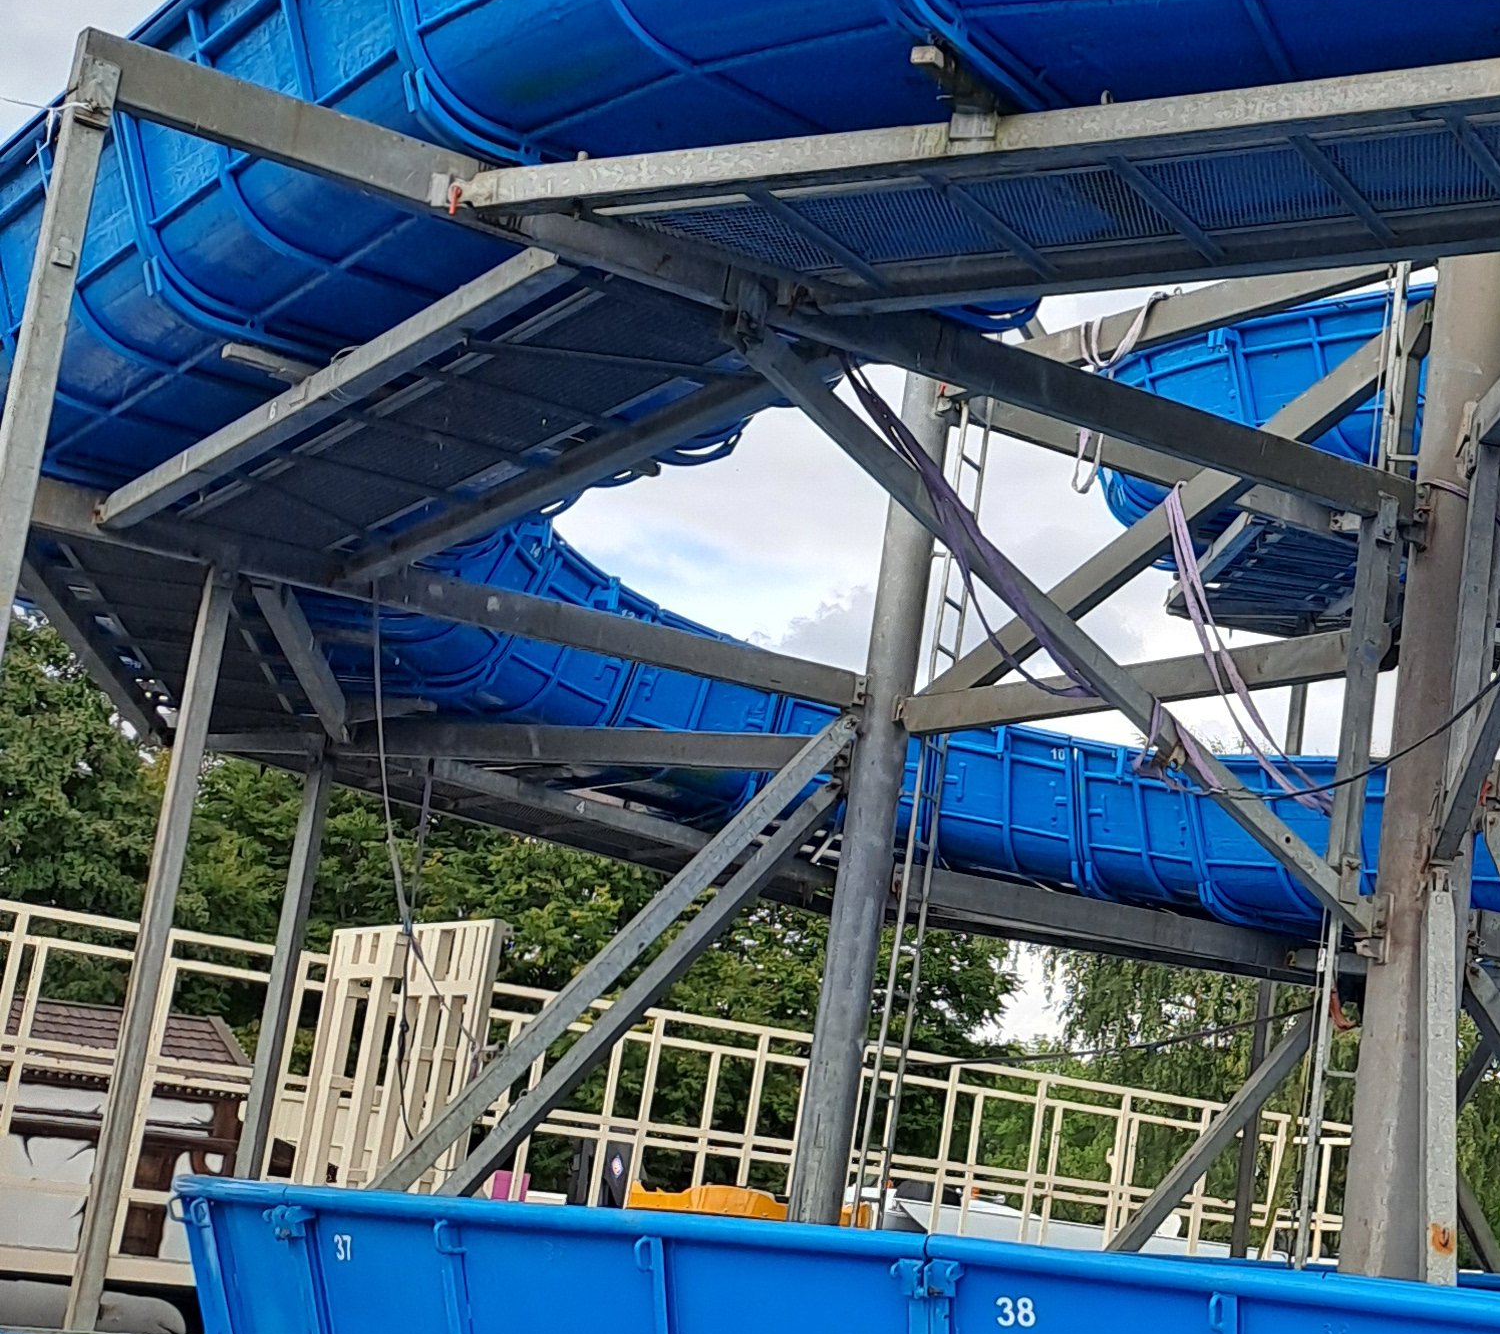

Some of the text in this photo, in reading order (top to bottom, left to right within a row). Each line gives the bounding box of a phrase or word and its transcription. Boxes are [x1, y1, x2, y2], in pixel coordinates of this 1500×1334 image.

[269, 401, 277, 421] 6
[1050, 747, 1066, 761] 10
[575, 800, 586, 814] 4
[333, 1234, 352, 1261] 37
[995, 1296, 1036, 1328] 38
